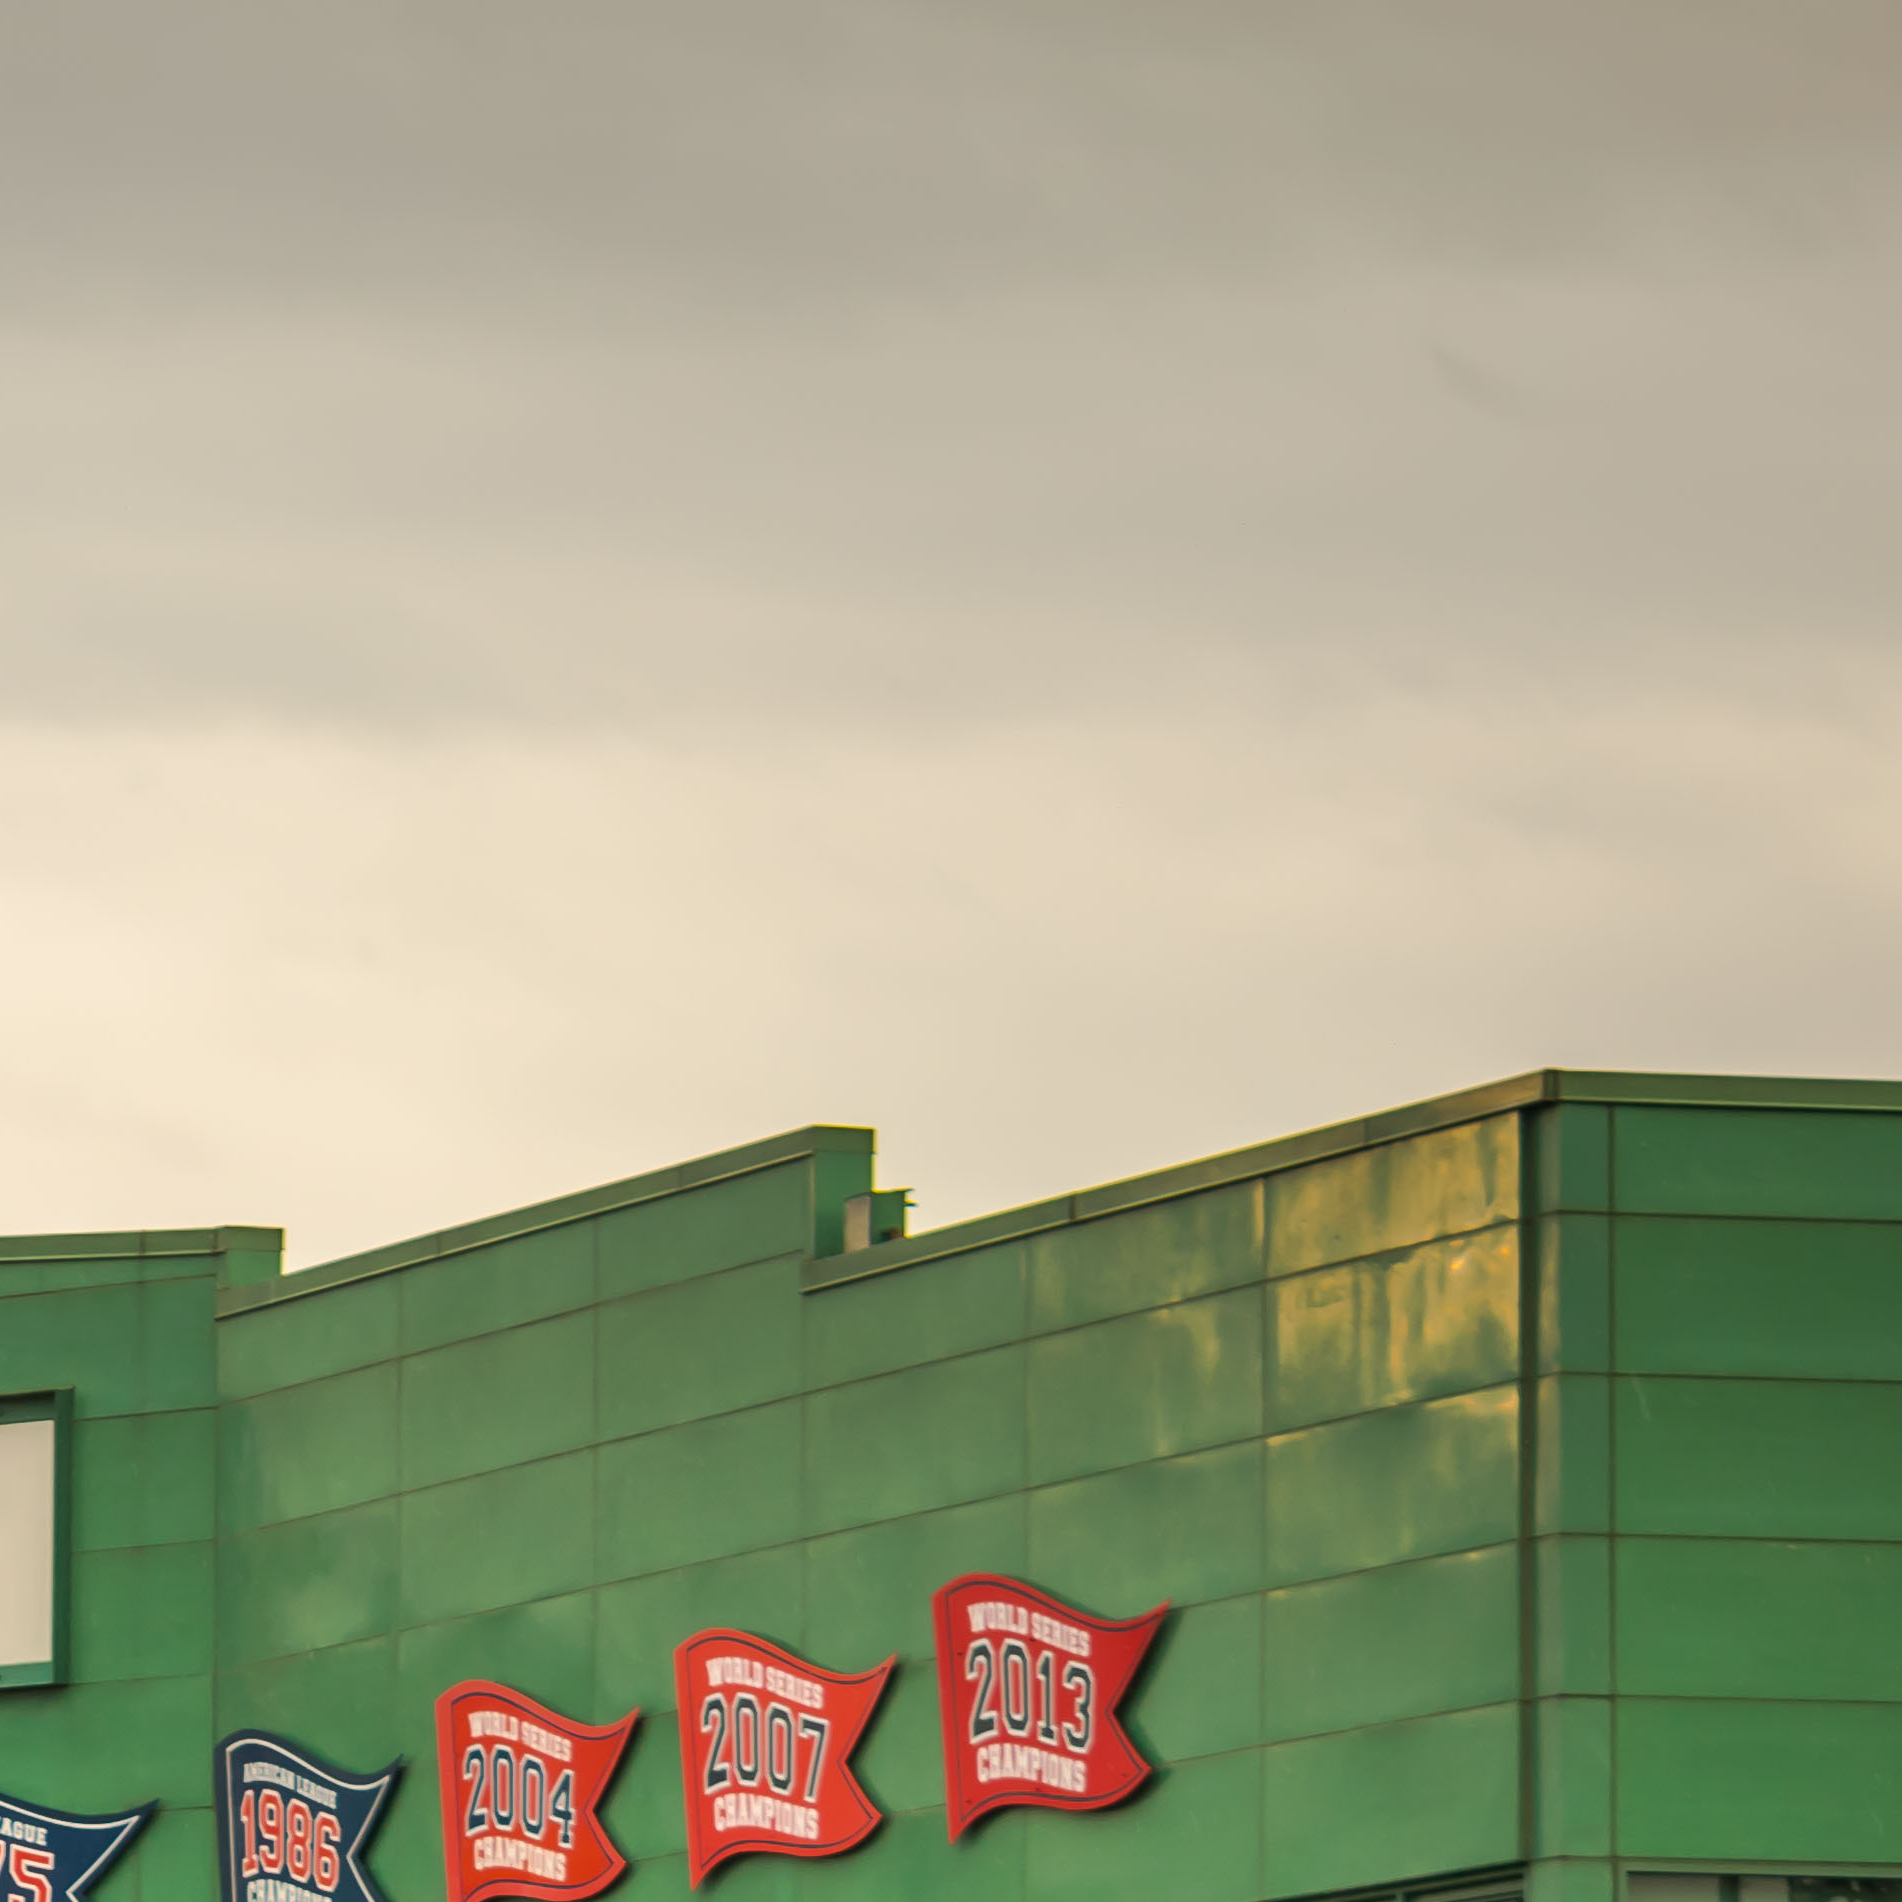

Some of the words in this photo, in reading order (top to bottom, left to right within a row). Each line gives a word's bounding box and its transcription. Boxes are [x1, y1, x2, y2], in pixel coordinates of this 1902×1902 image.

[967, 1600, 1026, 1636] WORLD
[1031, 1612, 1091, 1657] SERIES
[706, 1656, 760, 1690] WORLD
[764, 1667, 823, 1710] SERIES
[965, 1638, 1094, 1753] 2013
[468, 1711, 516, 1742] WORLD
[520, 1722, 572, 1763] SERIES
[701, 1692, 829, 1801] 2007
[243, 1762, 294, 1791] AMERICAN
[297, 1776, 337, 1810] LEAGUE
[976, 1744, 1087, 1793] CHAMPIONS
[462, 1744, 576, 1849] 2004
[714, 1797, 819, 1840] CHAMPIONS
[240, 1789, 342, 1893] 1986
[473, 1836, 567, 1882] CHAMPIONS
